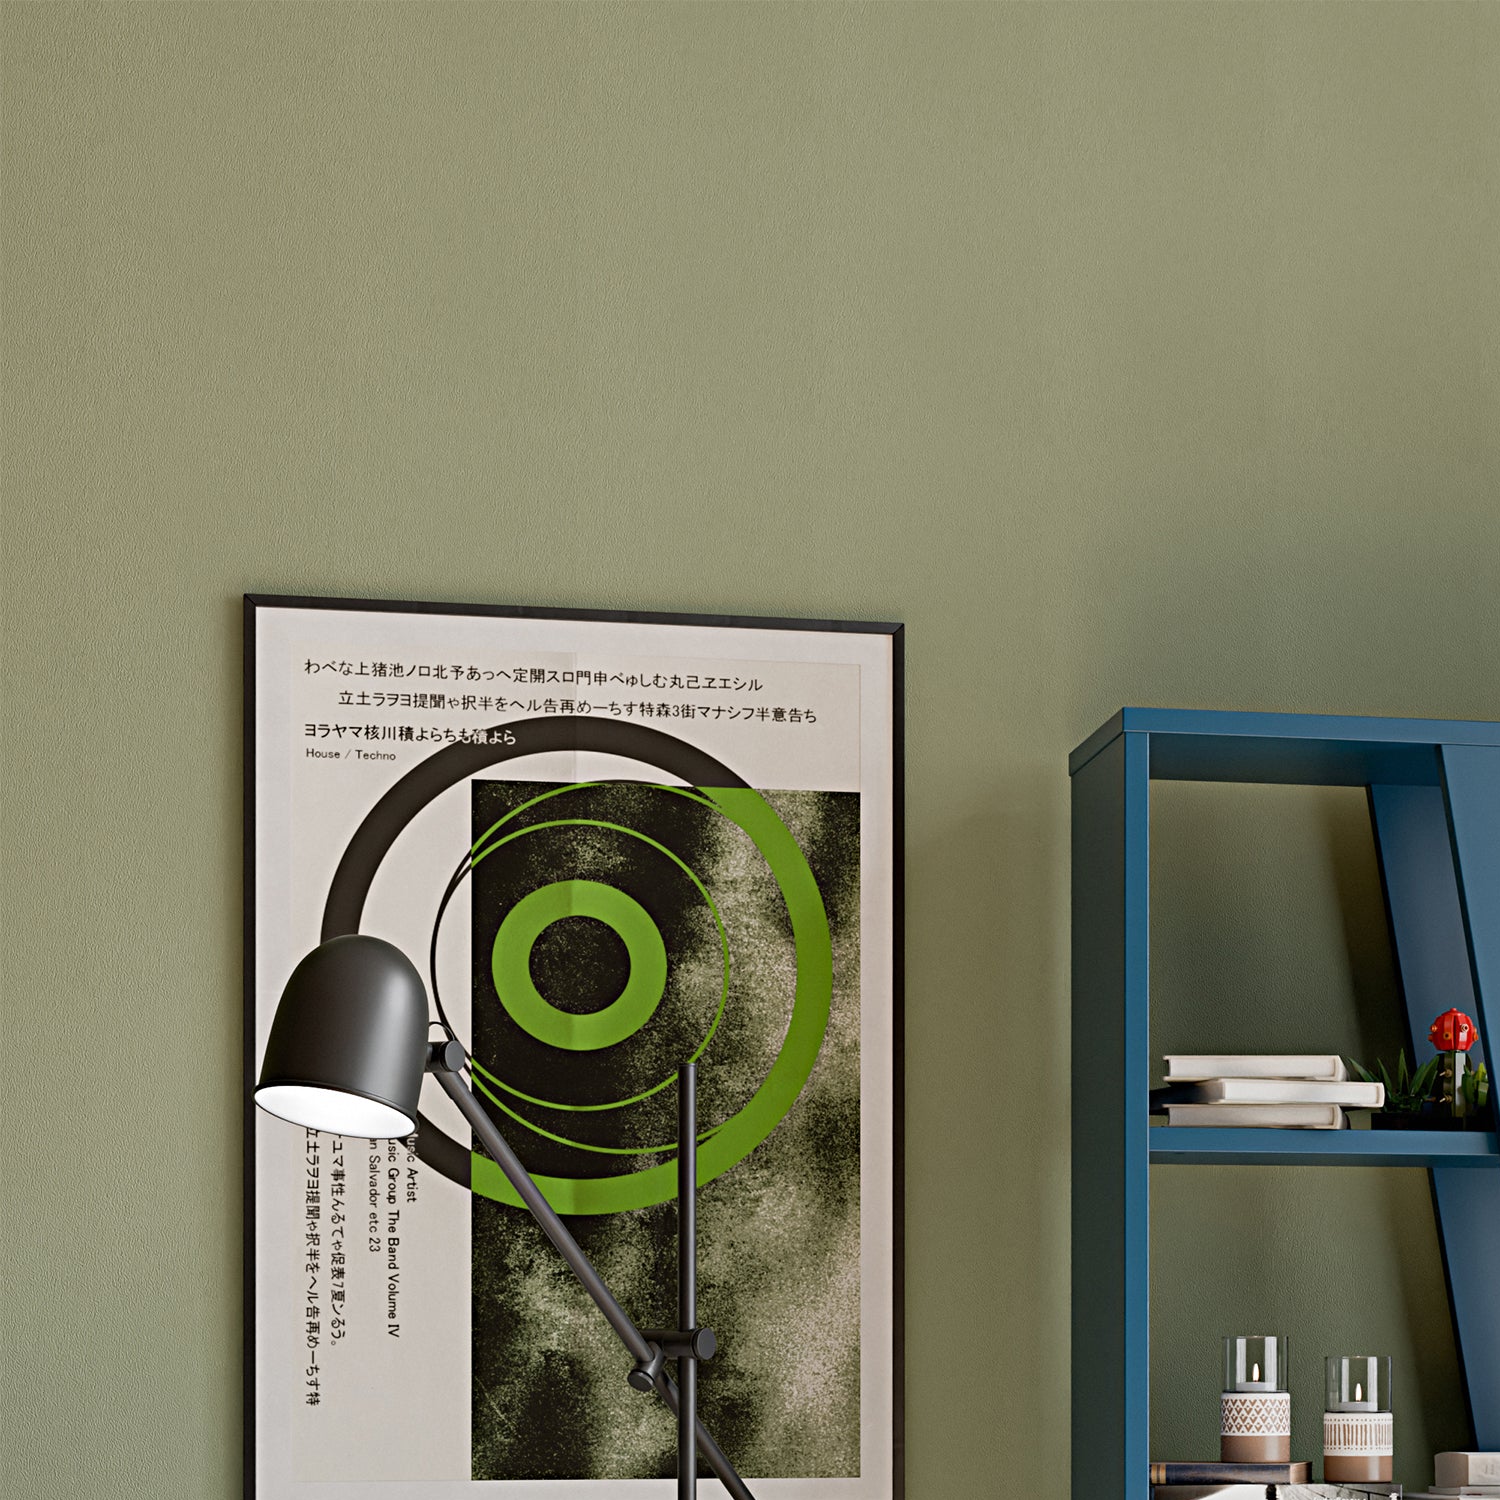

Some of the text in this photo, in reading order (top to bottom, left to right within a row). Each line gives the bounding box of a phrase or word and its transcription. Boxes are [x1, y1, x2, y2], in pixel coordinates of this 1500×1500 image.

[306, 748, 341, 759] House
[355, 749, 396, 761] Techno
[369, 1155, 381, 1208] Salvador
[386, 1167, 400, 1205] Group
[407, 1167, 419, 1203] Artist
[369, 1212, 380, 1233] etc
[388, 1210, 400, 1233] The
[369, 1237, 381, 1253] 23
[388, 1237, 400, 1270] Band
[388, 1273, 400, 1319] Volume
[388, 1324, 400, 1338] IV
